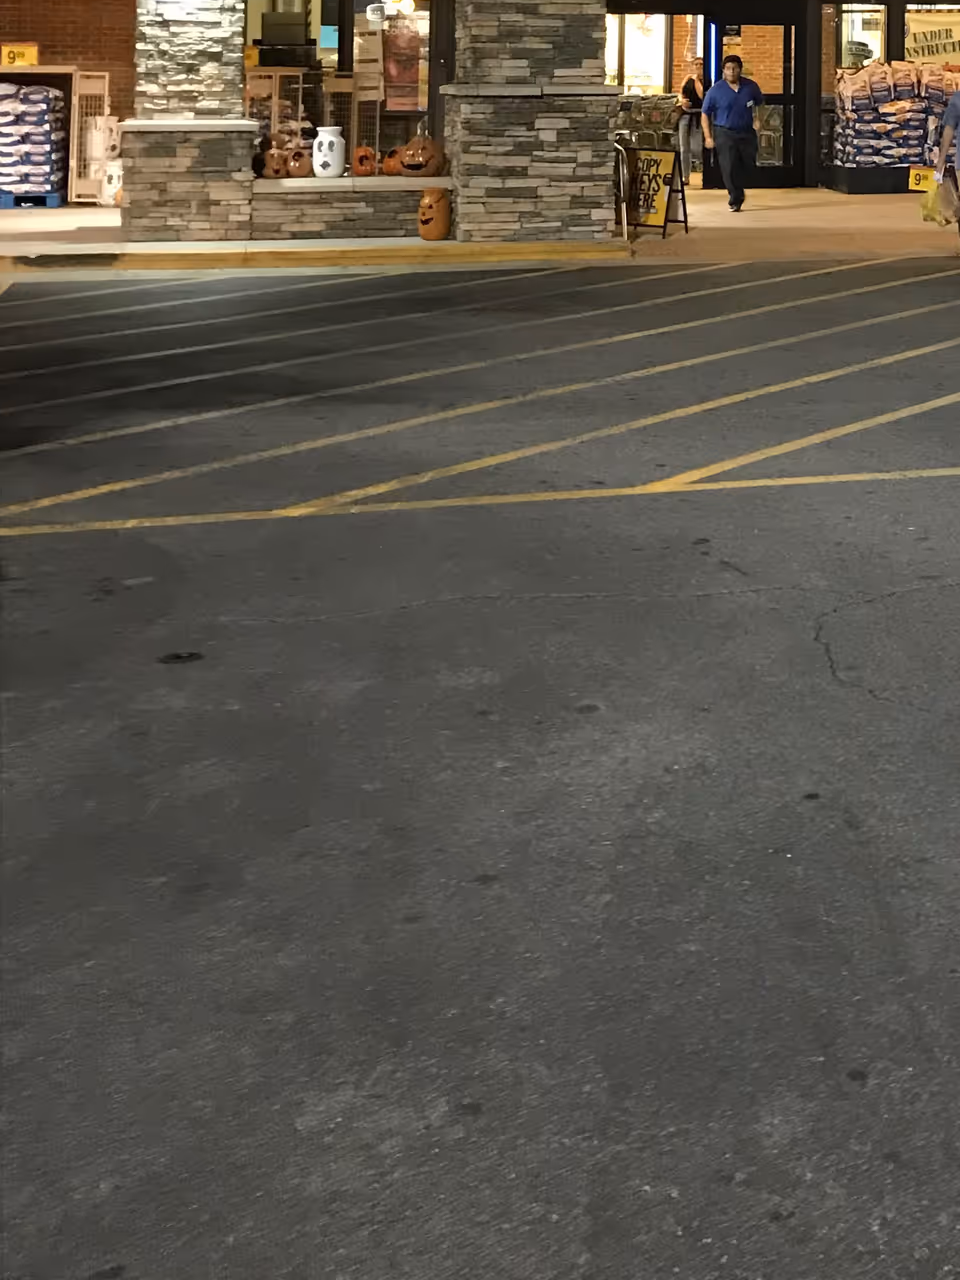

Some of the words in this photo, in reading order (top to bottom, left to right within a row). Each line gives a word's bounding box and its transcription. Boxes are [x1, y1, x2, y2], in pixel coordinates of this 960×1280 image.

[912, 28, 954, 44] UNDER
[634, 157, 662, 173] COPY
[630, 172, 662, 193] KEYS
